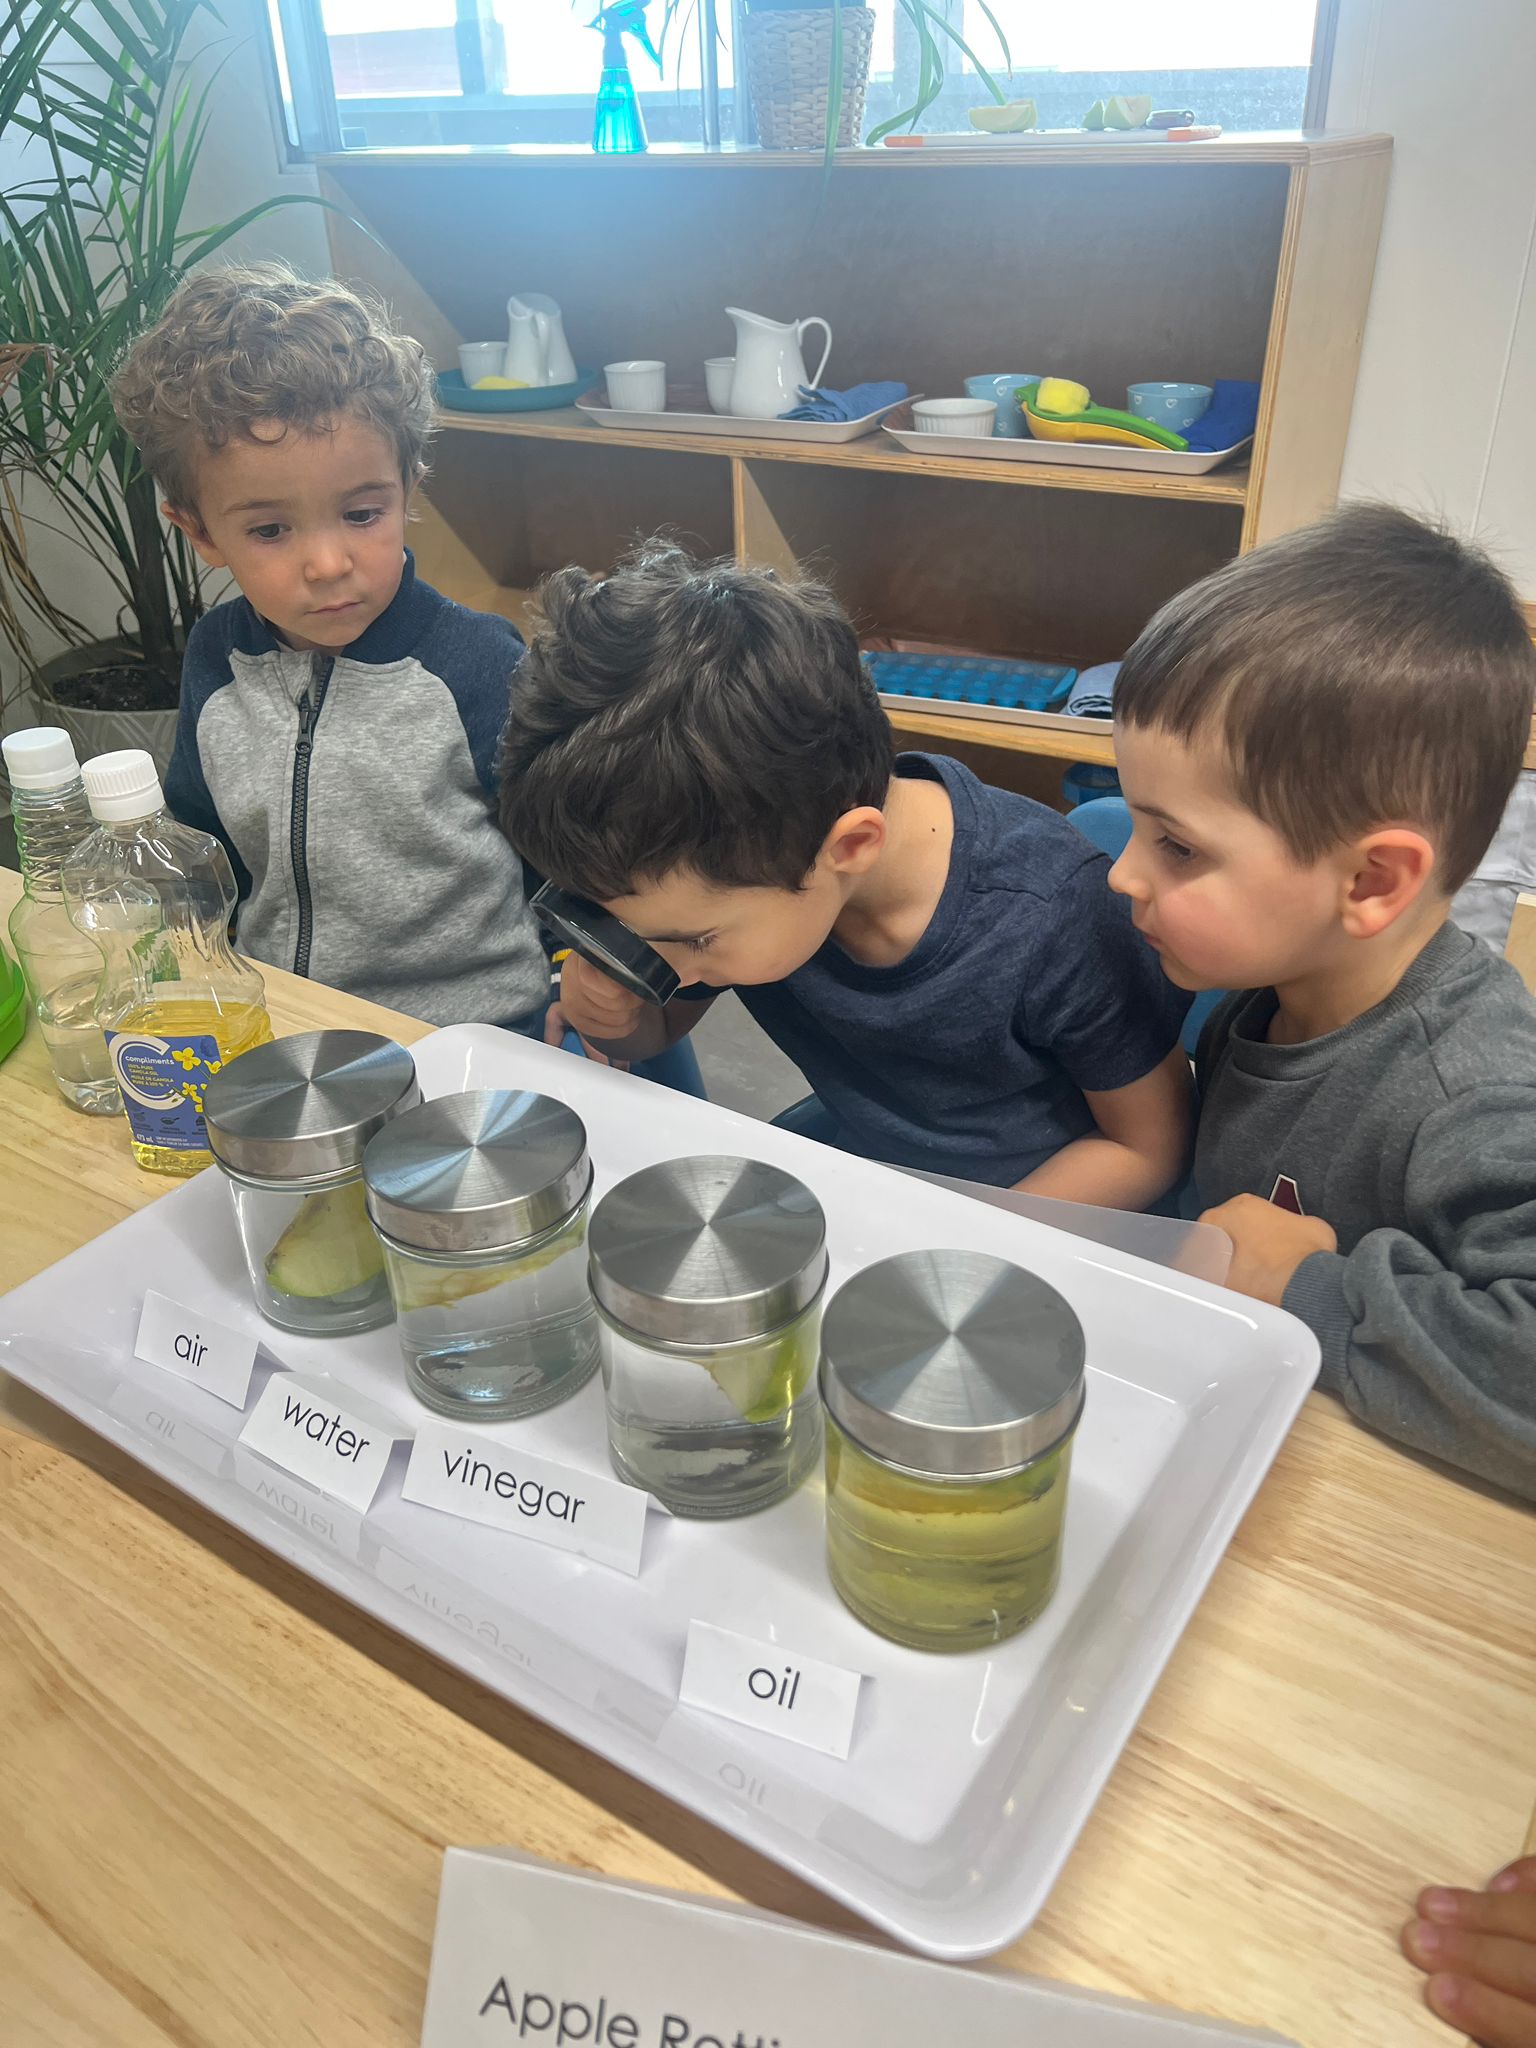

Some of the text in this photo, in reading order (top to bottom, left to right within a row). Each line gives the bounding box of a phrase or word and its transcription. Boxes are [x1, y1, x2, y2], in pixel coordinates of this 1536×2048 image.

[125, 1055, 175, 1065] compliments
[174, 1333, 208, 1367] air
[283, 1394, 370, 1464] water
[444, 1448, 585, 1523] vinegar
[747, 1666, 801, 1710] oil
[478, 1975, 640, 2048] Apple
